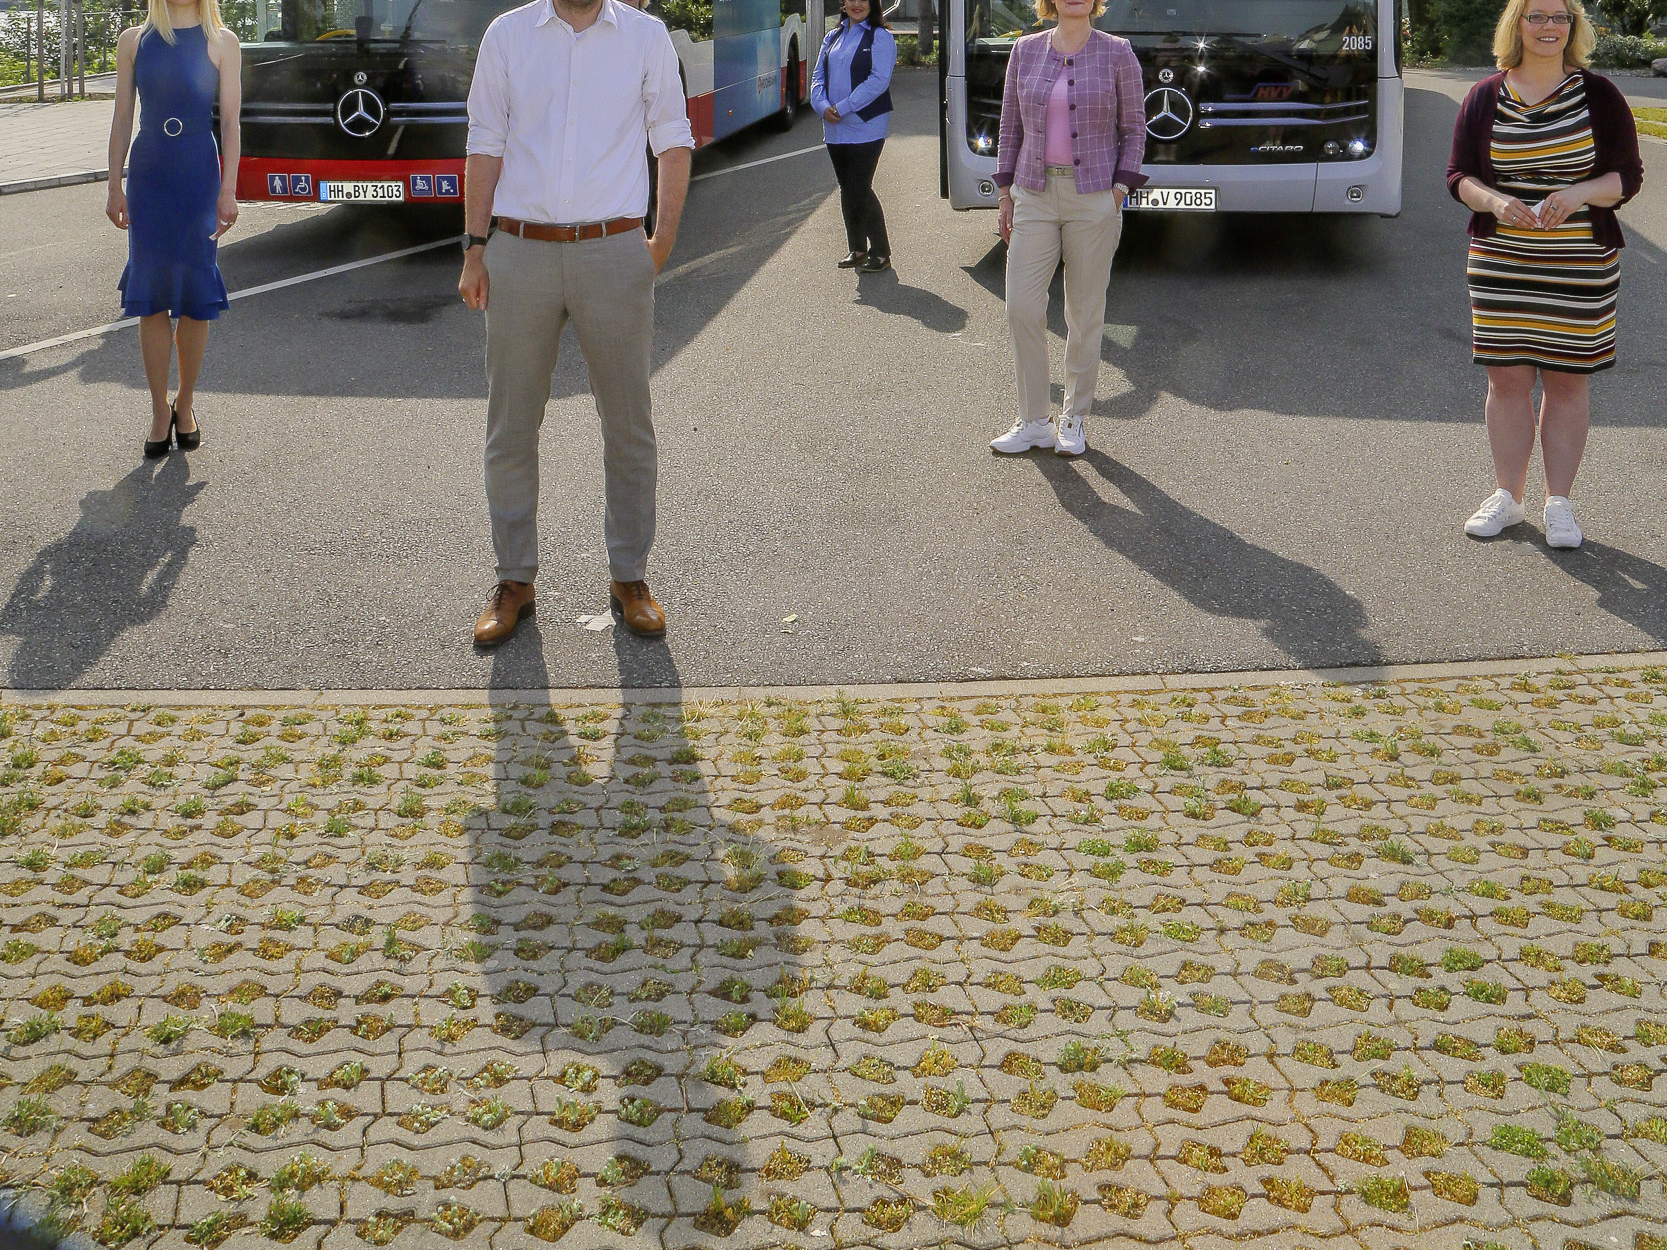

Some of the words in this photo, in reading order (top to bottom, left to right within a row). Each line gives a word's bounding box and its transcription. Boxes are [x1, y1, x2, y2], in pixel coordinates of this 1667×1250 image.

[1342, 36, 1372, 50] 2085
[1257, 86, 1293, 99] HVV
[328, 185, 344, 199] HH
[353, 185, 368, 199] BY
[371, 185, 401, 199] 3103
[1129, 190, 1149, 206] HH
[1160, 191, 1170, 206] V
[1174, 191, 1213, 206] 9085
